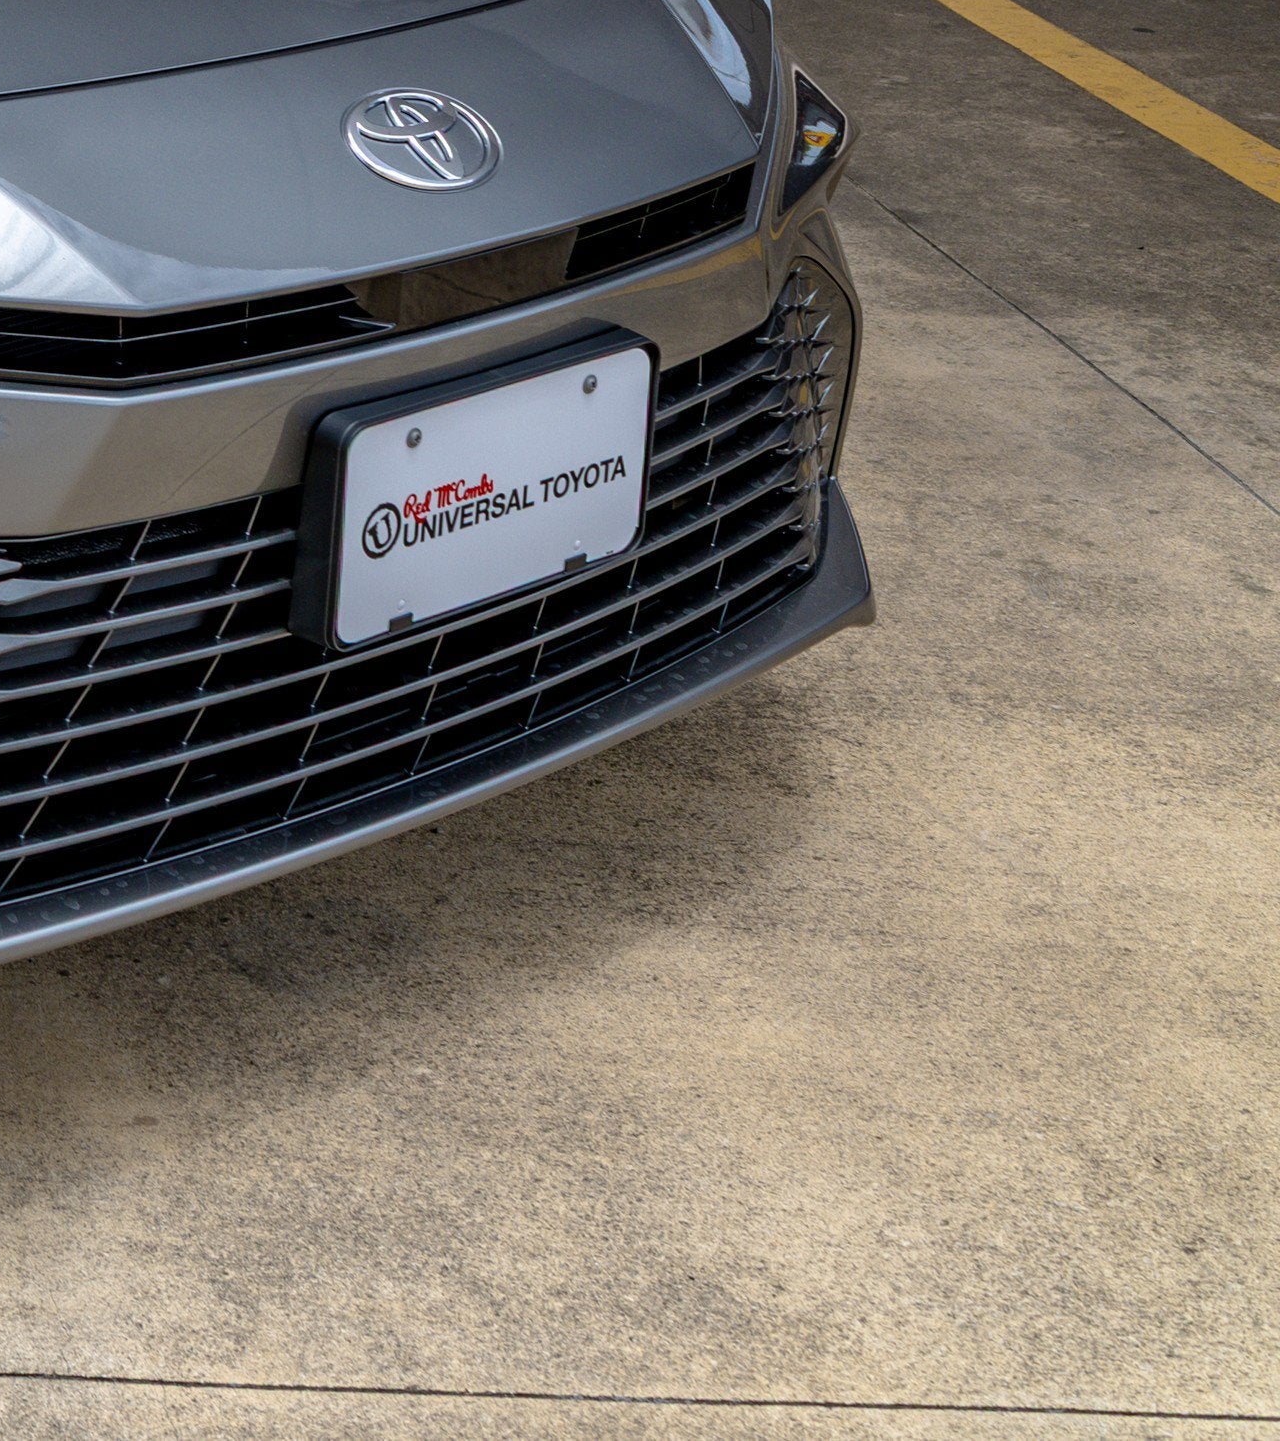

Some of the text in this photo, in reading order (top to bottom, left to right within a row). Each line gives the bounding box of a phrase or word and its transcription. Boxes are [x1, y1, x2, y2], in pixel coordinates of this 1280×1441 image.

[403, 455, 627, 547] UNIVERSAL TOYOTA
[404, 473, 494, 523] Red McCombs
